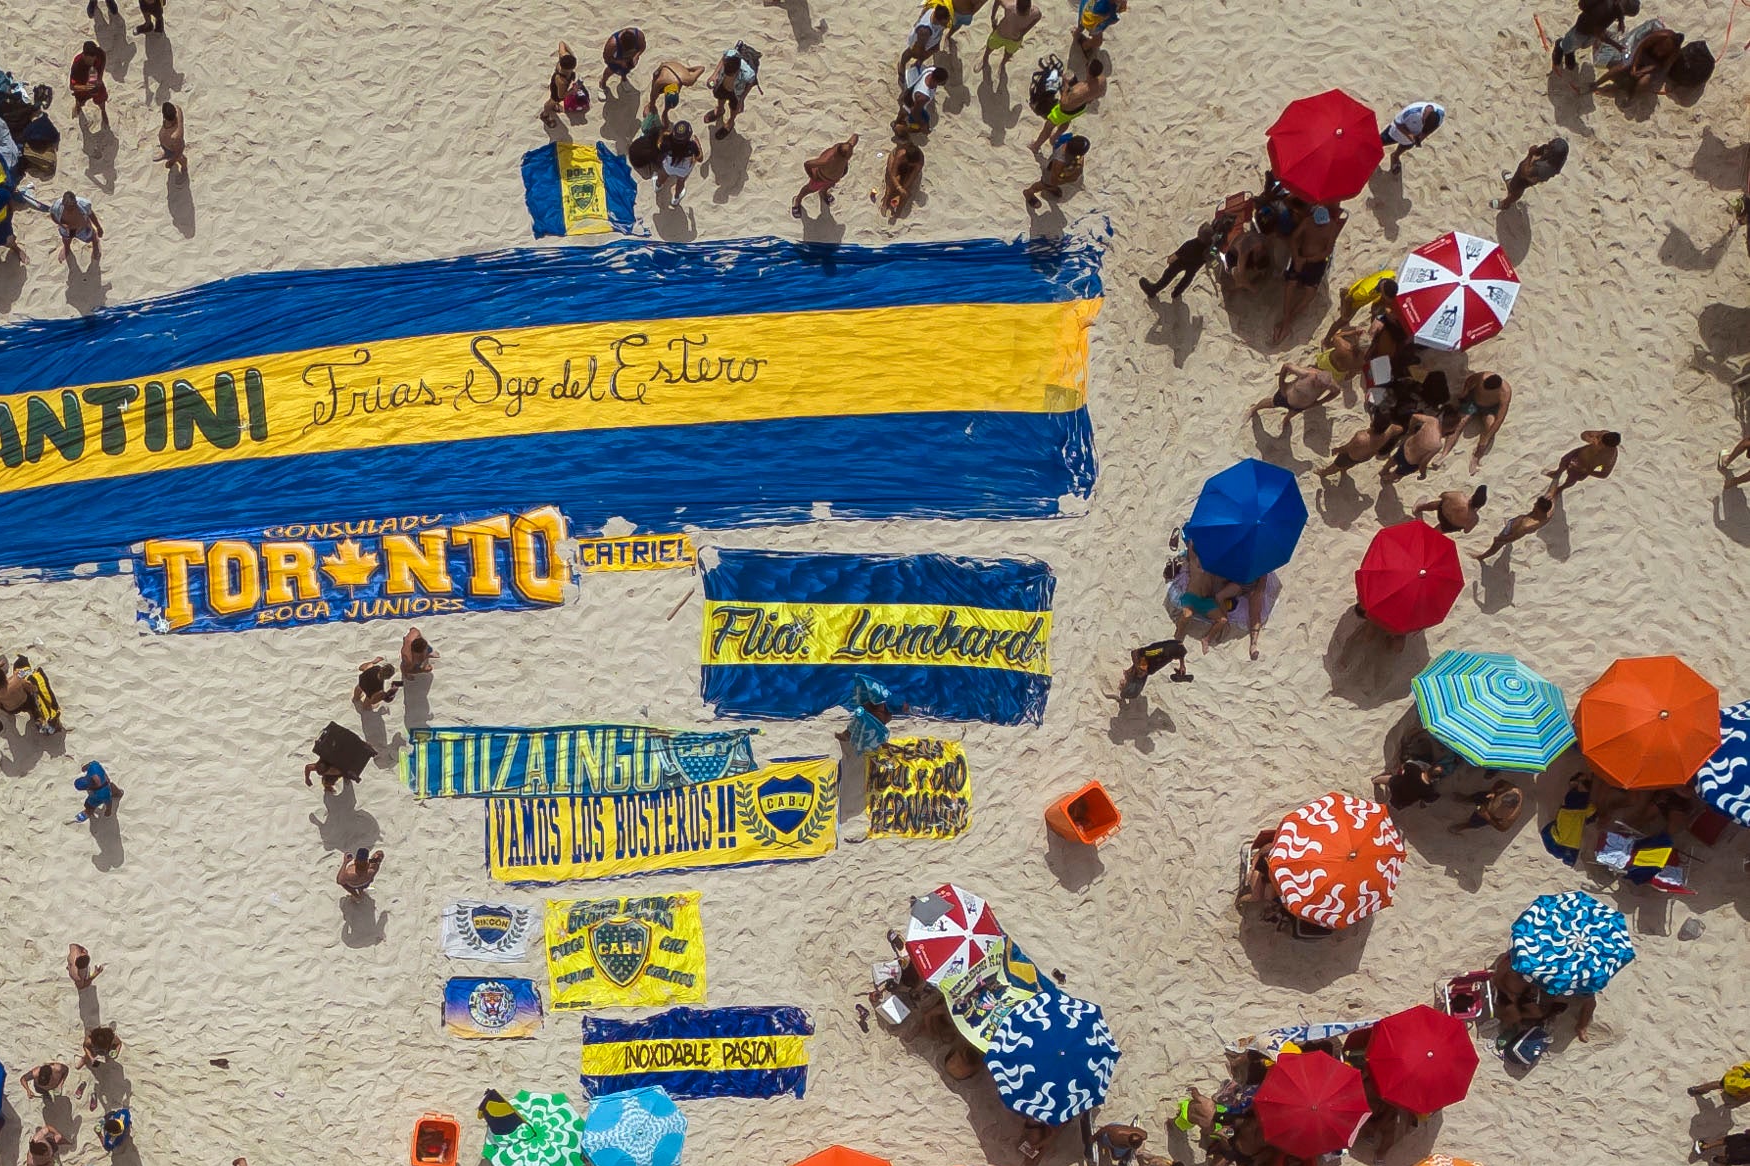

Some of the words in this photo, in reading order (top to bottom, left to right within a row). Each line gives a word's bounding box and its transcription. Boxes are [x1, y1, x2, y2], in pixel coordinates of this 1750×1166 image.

[302, 348, 442, 434] Frias
[550, 355, 605, 401] del
[610, 333, 767, 405] Estero
[263, 513, 443, 539] CONSULADO
[578, 536, 692, 566] CATRIEL
[257, 601, 330, 625] BOCA
[344, 598, 465, 618] JUNIORS
[766, 796, 806, 808] CABJ
[496, 798, 562, 867] VAMOS
[571, 797, 605, 864] LOS
[598, 941, 642, 955] CABJ
[624, 1042, 711, 1070] INOXIDABLE
[722, 1040, 777, 1068] PASION
